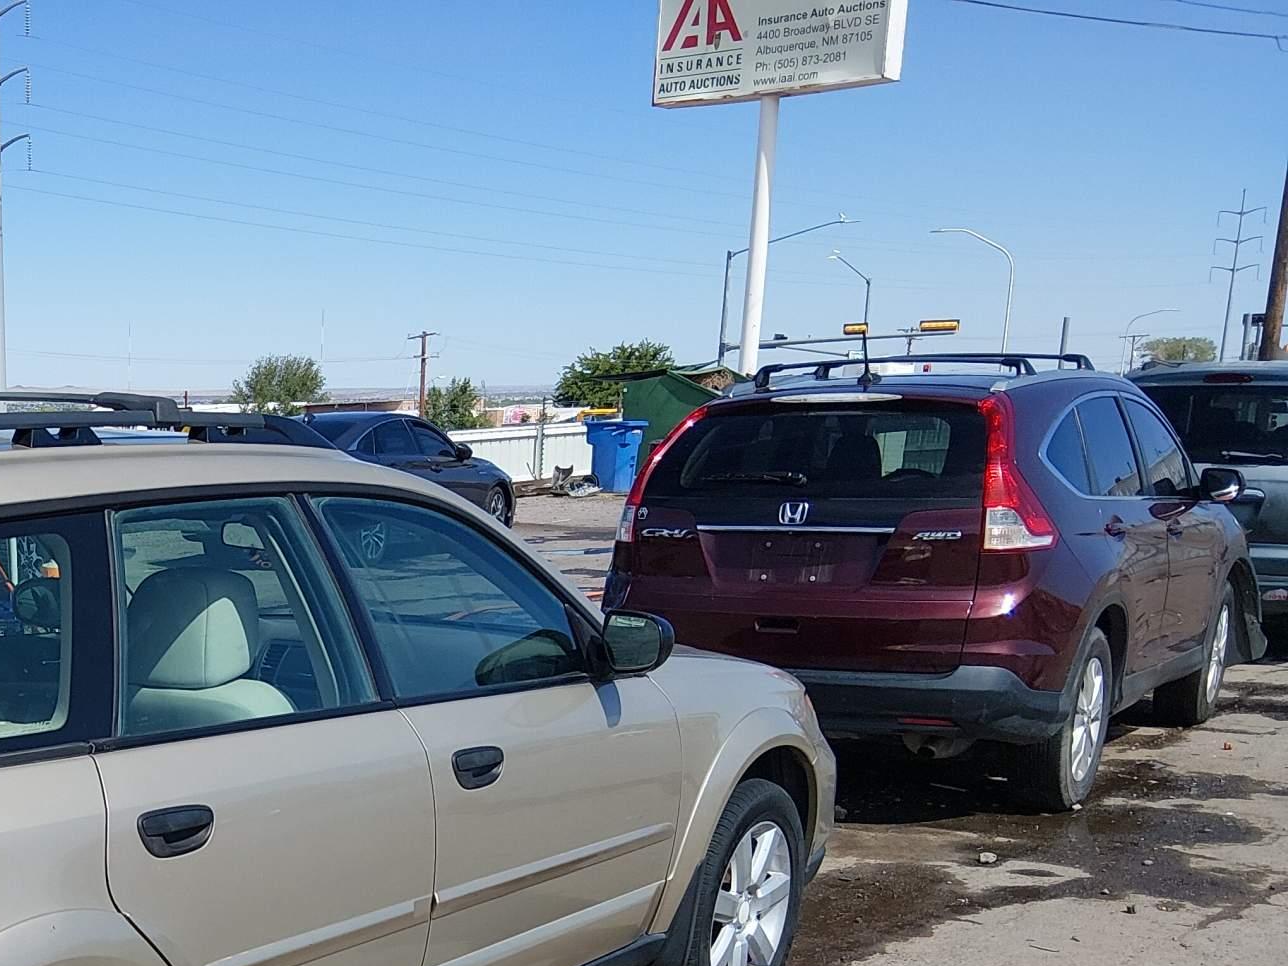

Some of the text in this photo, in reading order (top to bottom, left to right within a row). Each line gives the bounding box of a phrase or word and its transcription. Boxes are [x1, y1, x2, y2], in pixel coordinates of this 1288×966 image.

[758, 0, 886, 26] Insurance Auto Auctions
[757, 14, 880, 40] 4400 Broadway BLVD SE
[756, 31, 872, 56] Albuquerque, NM 87105
[660, 54, 742, 74] INSURANCE
[755, 51, 847, 72] Ph: (505) 873-2081
[658, 74, 741, 94] AUTO AUCTIONS
[912, 531, 962, 540] AWD
